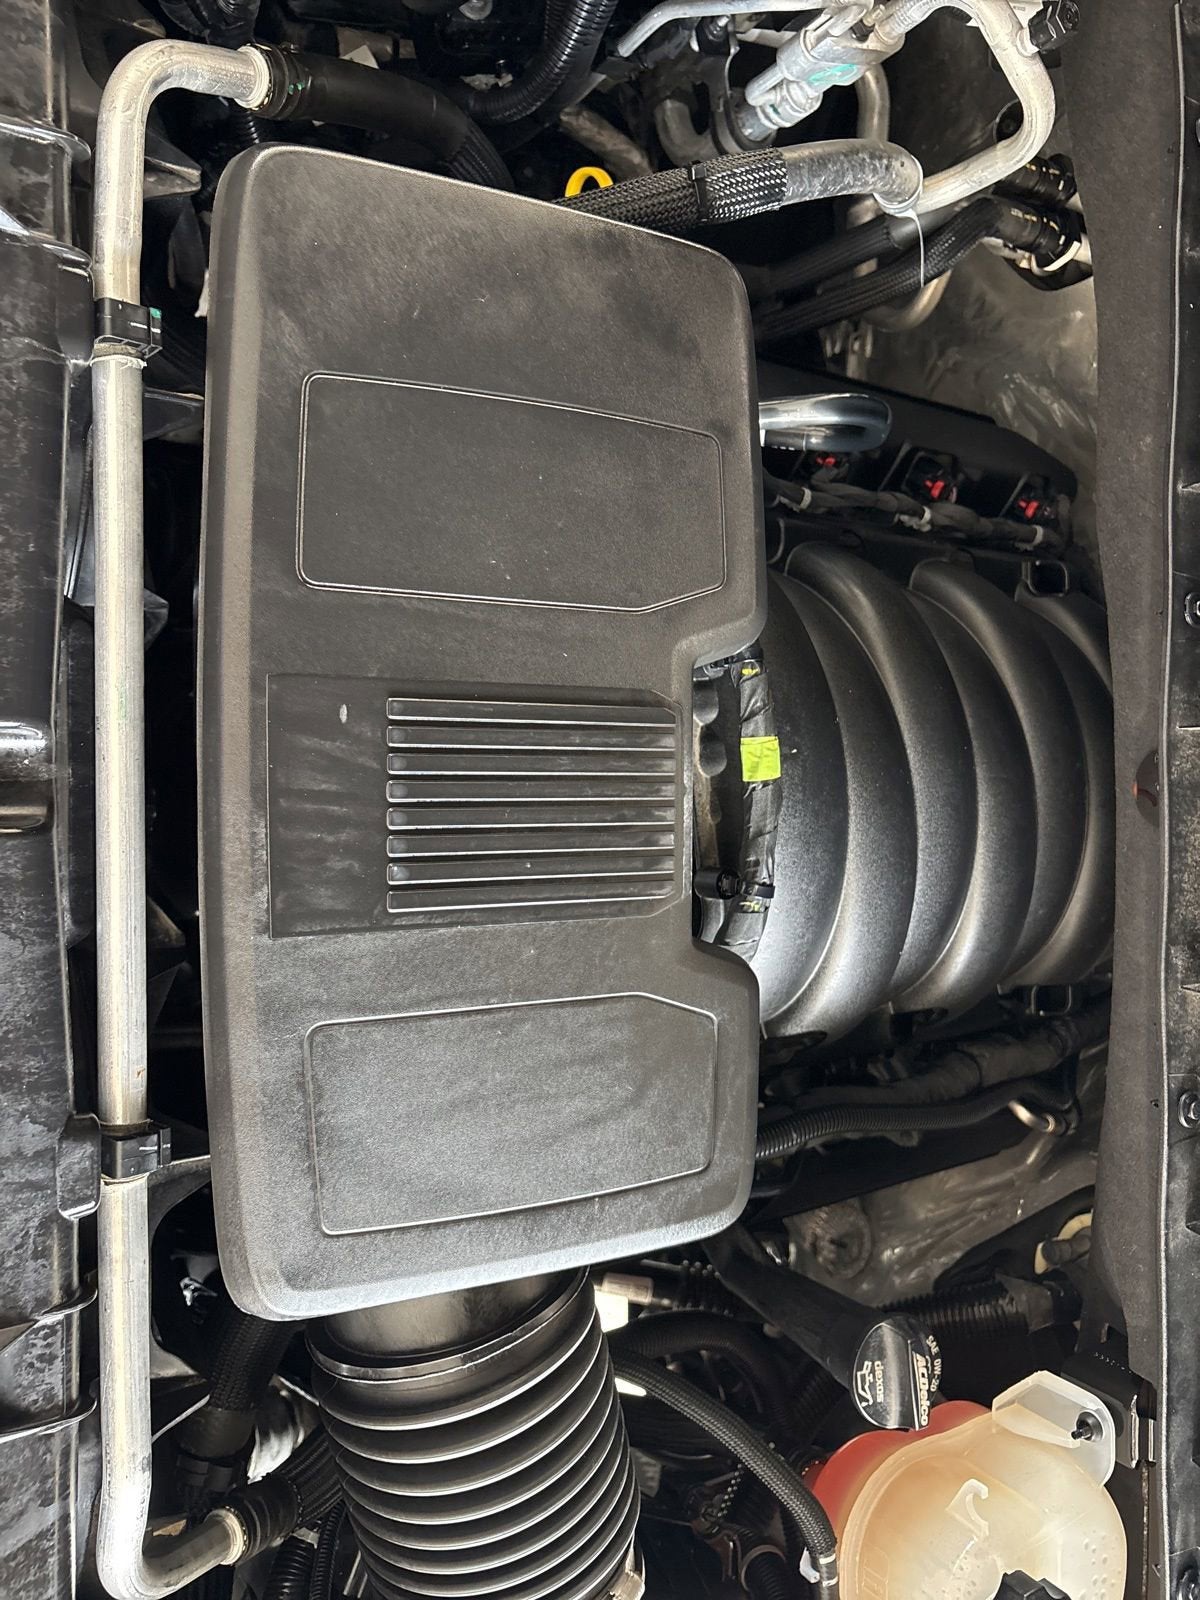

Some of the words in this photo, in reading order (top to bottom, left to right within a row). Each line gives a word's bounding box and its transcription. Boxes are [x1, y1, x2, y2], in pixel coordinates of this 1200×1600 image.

[926, 1335, 940, 1356] SAE
[874, 1360, 884, 1403] dexos
[916, 1352, 931, 1426] ACDelco
[930, 1358, 942, 1392] 0W-20
